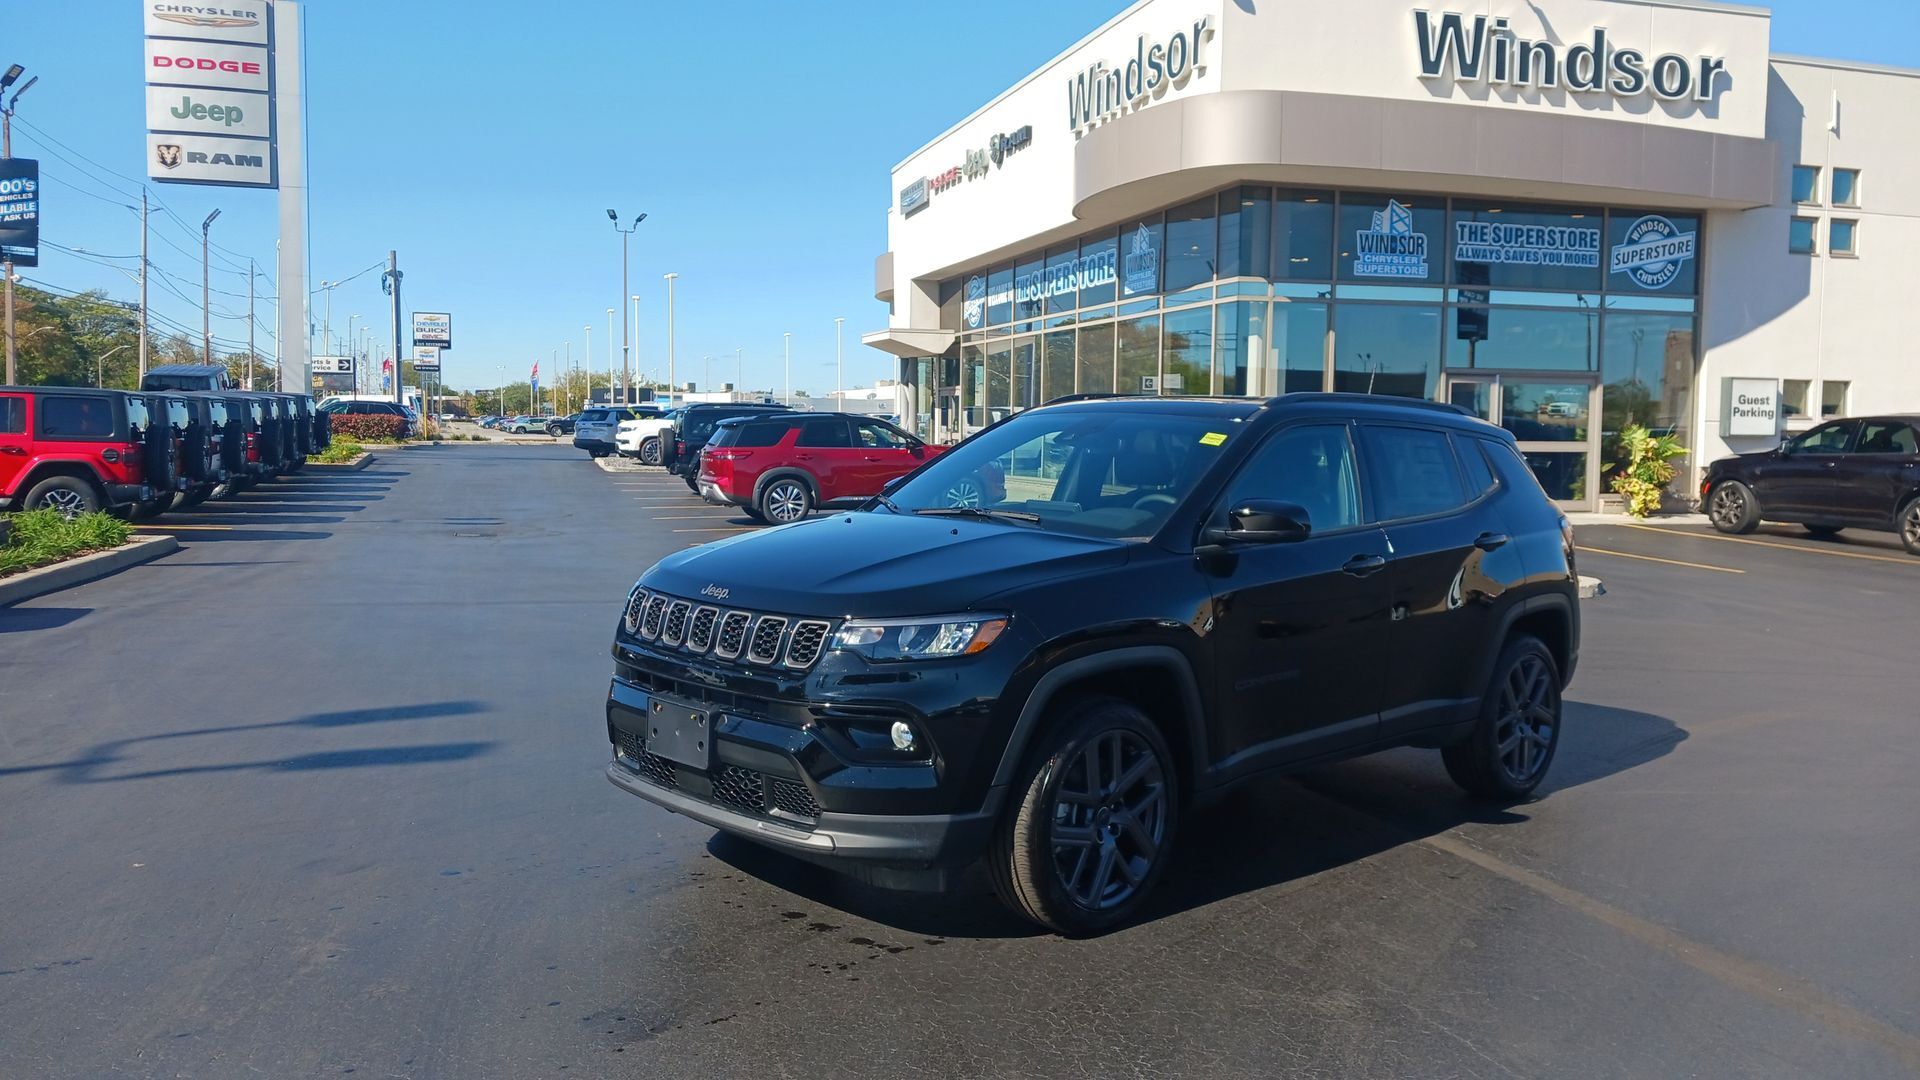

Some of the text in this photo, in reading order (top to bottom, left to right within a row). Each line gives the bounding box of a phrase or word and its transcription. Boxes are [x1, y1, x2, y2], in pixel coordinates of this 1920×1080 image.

[154, 4, 258, 19] CHRYSLER
[153, 55, 260, 75] DODGE
[1411, 9, 1726, 101] Windsor
[1068, 15, 1212, 133] Windsor
[170, 96, 243, 127] Jeep
[187, 151, 262, 168] RAM
[0, 192, 33, 202] EHICLES
[0, 202, 36, 214] ILABLE
[1457, 223, 1598, 249] THE SUPERSTORE
[1631, 220, 1670, 241] WINDSOR
[1360, 233, 1425, 255] WINDSOR
[1614, 239, 1692, 266] SUPERSTORE
[1364, 254, 1418, 264] CHRYSLER
[1457, 247, 1502, 260] ALWAYS
[1504, 248, 1540, 262] SAVES
[1542, 249, 1563, 263] YOU
[1031, 250, 1117, 300] SUPERSTORE
[1357, 264, 1425, 275] SUPERSTORE
[1636, 263, 1675, 284] CHRYSLER
[1738, 394, 1770, 405] Guest
[1733, 407, 1775, 420] Parking
